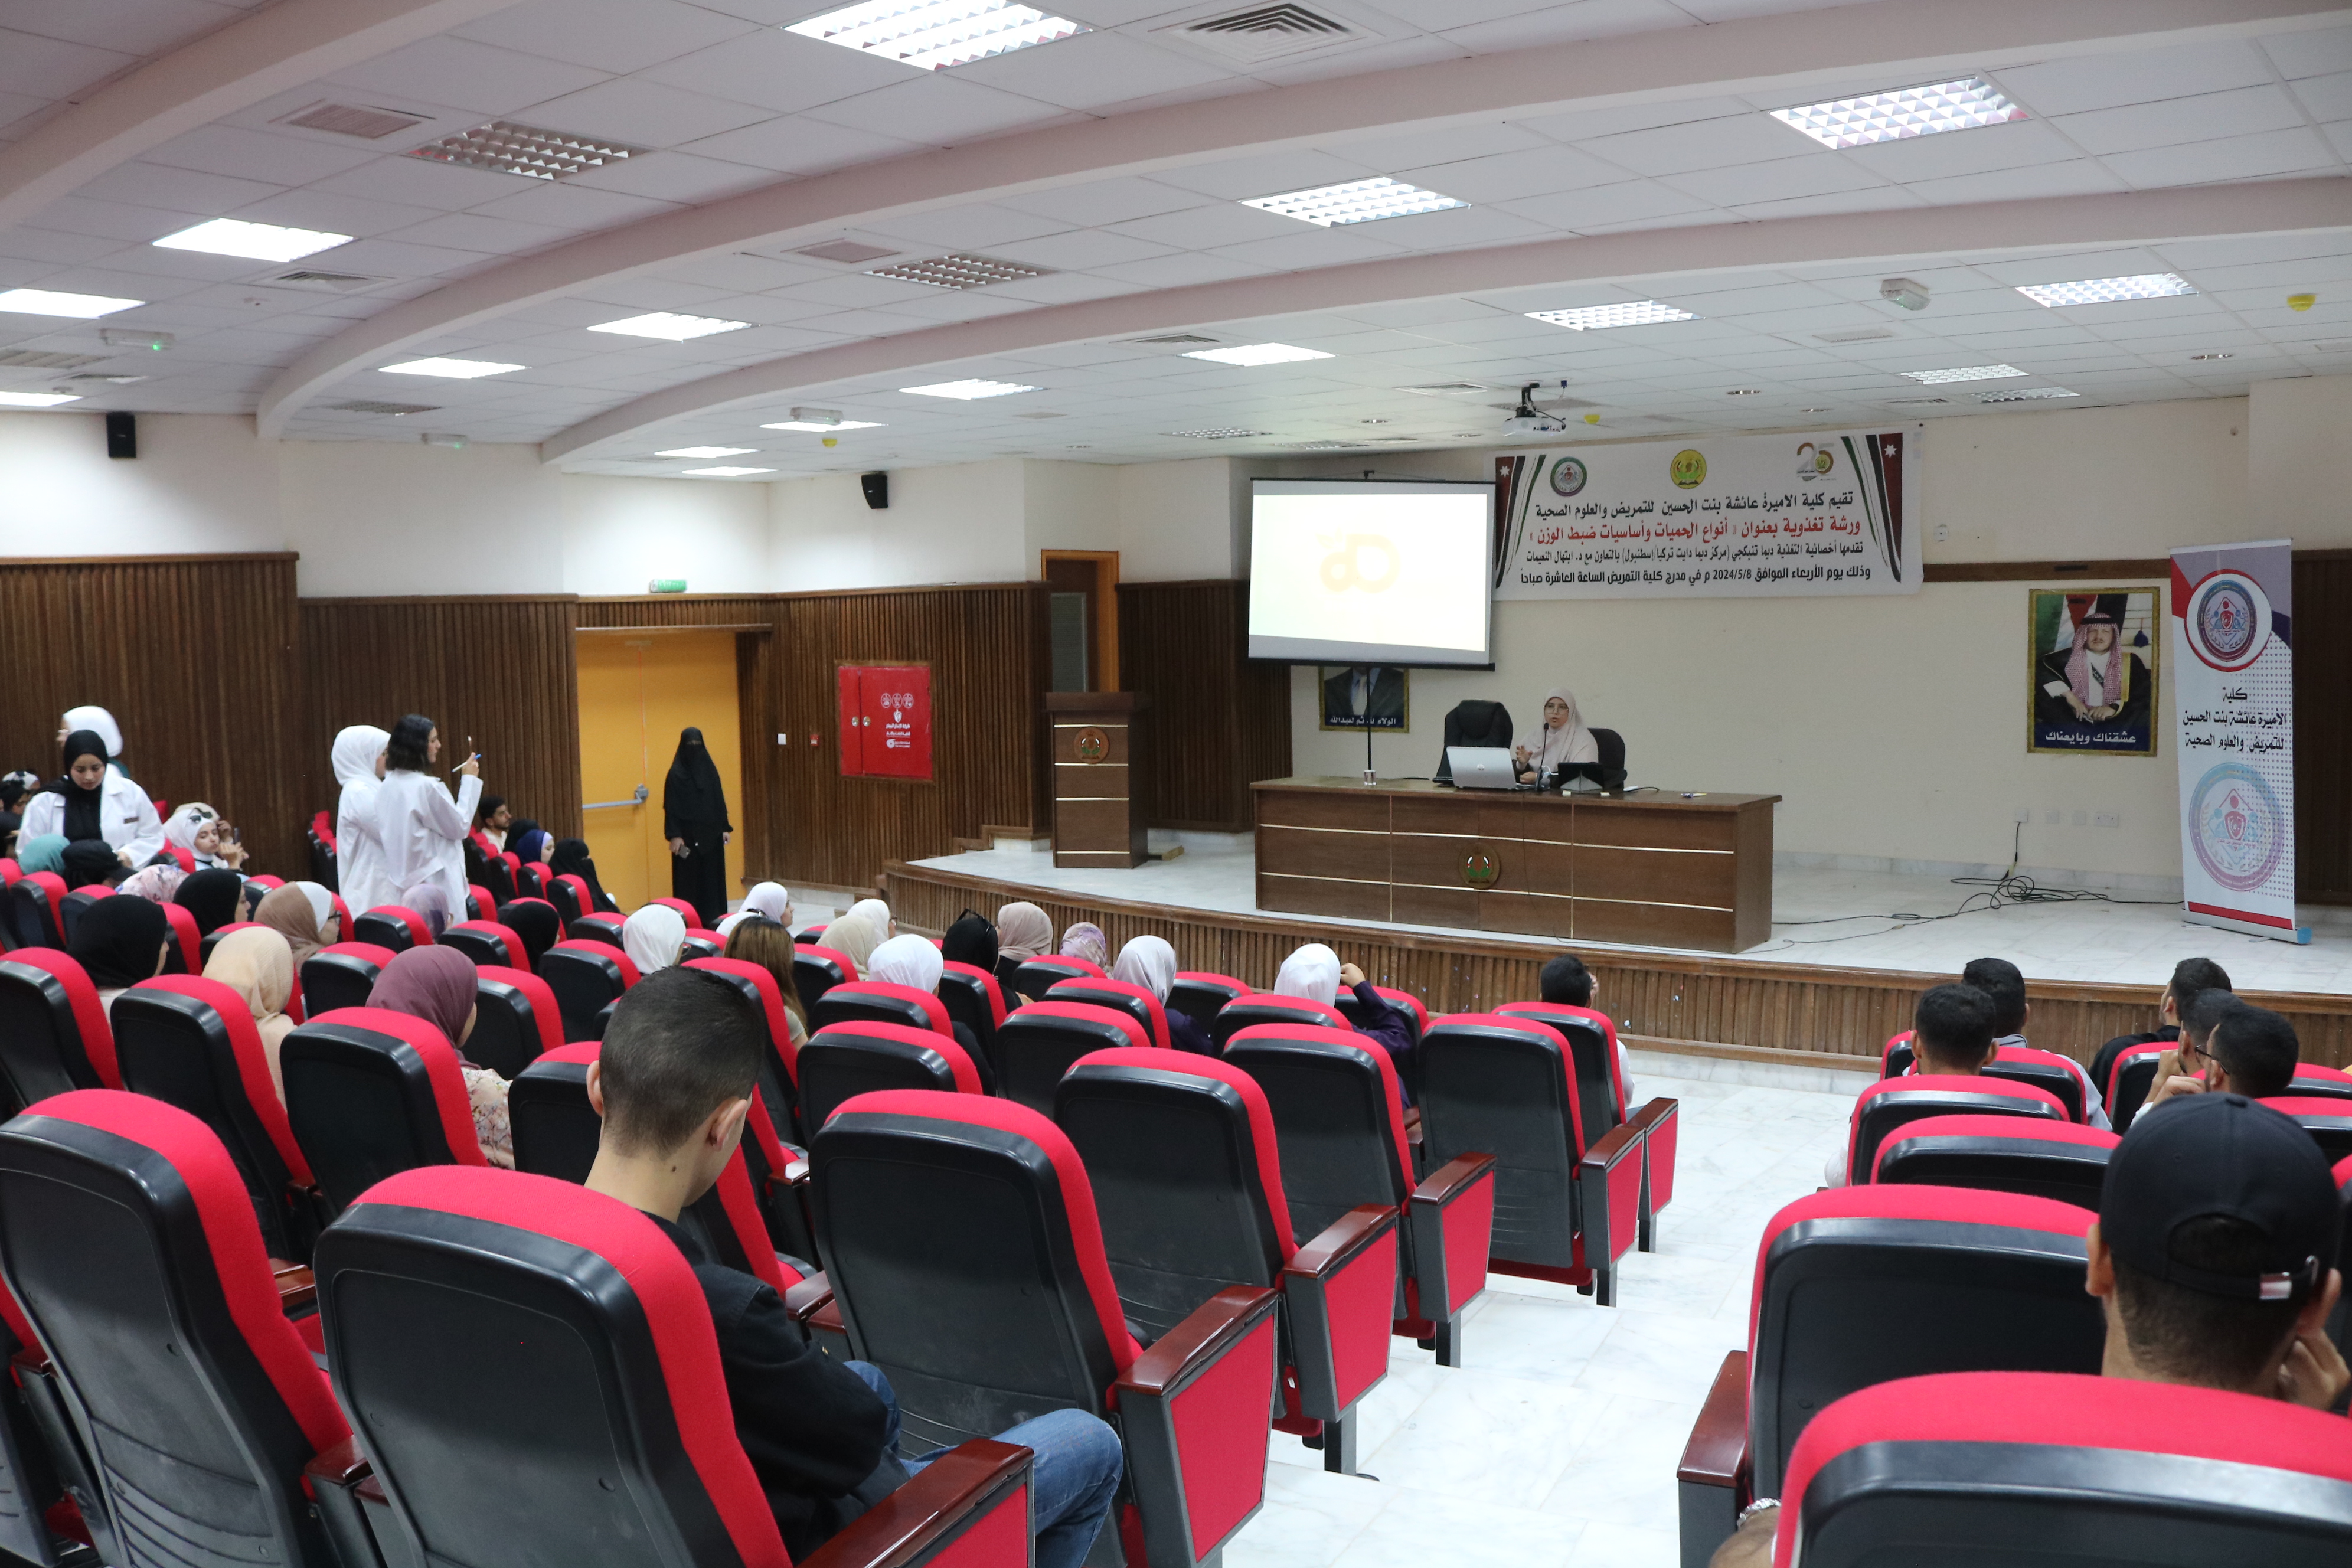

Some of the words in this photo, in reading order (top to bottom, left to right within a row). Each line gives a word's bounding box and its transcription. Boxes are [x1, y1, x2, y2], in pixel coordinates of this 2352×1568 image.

[1611, 499, 1654, 518] للتمريض
[1662, 499, 1697, 515] الحسين
[1701, 498, 1721, 515] بنت
[1726, 496, 1758, 509] عائشة
[1802, 492, 1825, 511] كلية
[1829, 491, 1853, 510] تقيم
[1536, 504, 1570, 520] الصحية
[1575, 503, 1608, 520] والعلوم
[1600, 520, 1651, 543] وأساسيات
[1655, 522, 1697, 543] الحميات
[1703, 517, 1728, 543] أنواع
[1742, 520, 1778, 538] بعنوان
[1783, 516, 1824, 537] تغذوية
[1830, 515, 1860, 535] ورشة
[1537, 527, 1563, 544] الوزن
[1568, 526, 1596, 545] ضبط
[1576, 551, 1582, 561] د.
[1595, 548, 1620, 563] بالتعاون
[1676, 548, 1692, 562] دايت
[1695, 547, 1707, 562] ديما
[1710, 544, 1730, 562] (مركز
[1732, 545, 1758, 561] تنبكجي
[1762, 545, 1773, 559] ديما
[1777, 543, 1802, 559] التغذية
[1805, 540, 1837, 557] أخصائية
[1840, 541, 1863, 557] تقدمها
[1527, 550, 1552, 565] النعيمات
[1554, 550, 1573, 564] ابتهال
[1584, 552, 1592, 566] مع
[1546, 572, 1574, 585] العاشرة
[1578, 571, 1604, 582] الساعة
[1608, 571, 1640, 584] التمريض
[1644, 570, 1662, 583] كلية
[1666, 571, 1685, 584] مدرج
[1688, 569, 1701, 586] في
[1703, 574, 1710, 584] م
[1713, 569, 1752, 580] 2024/5/8
[1755, 567, 1788, 582] الموافق
[1792, 564, 1823, 582] الأربعاء
[1826, 569, 1843, 581] يوم
[1847, 565, 1871, 580] وذلك
[2222, 687, 2248, 703] كلية
[2183, 710, 2210, 725] الحسين
[2214, 711, 2228, 727] بنت
[2230, 710, 2256, 726] عائشة
[2258, 708, 2286, 729] الأميرة
[2046, 731, 2090, 745] وبايعناك
[2093, 730, 2137, 743] عشقناك
[2185, 733, 2215, 749] الصحية
[2219, 735, 2244, 751] والعلوم
[2249, 736, 2284, 752] للتمريض
